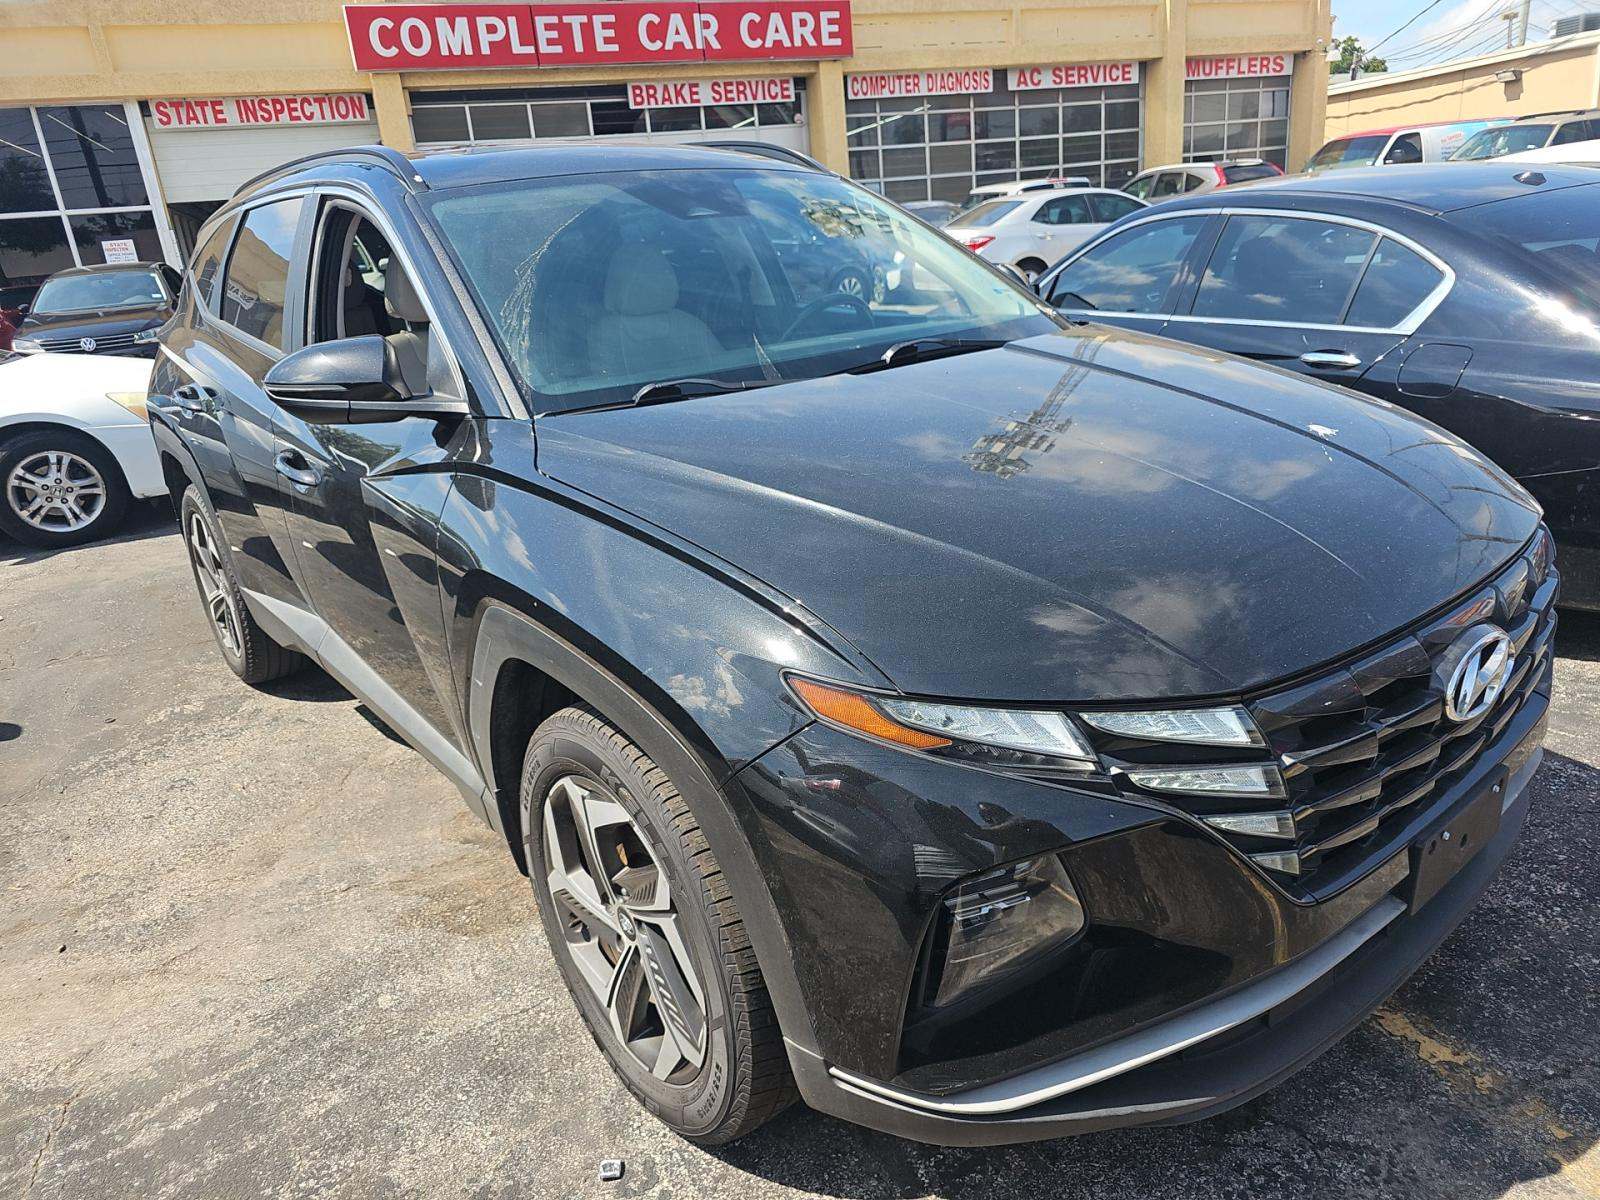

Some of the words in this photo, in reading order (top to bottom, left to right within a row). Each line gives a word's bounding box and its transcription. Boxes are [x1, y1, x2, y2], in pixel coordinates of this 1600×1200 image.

[368, 14, 620, 58] COMPLETE
[637, 12, 721, 50] CAR
[739, 11, 842, 49] CARE
[1016, 67, 1042, 87] AC
[1051, 63, 1132, 85] SERVICE
[1186, 56, 1285, 77] MUFFLERS
[632, 83, 701, 106] BRAKE
[711, 79, 791, 103] SERVICE
[851, 75, 921, 96] COMPUTER
[926, 71, 990, 93] DIAGNOSIS
[155, 101, 227, 126] STATE
[236, 95, 366, 123] INSPECTION
